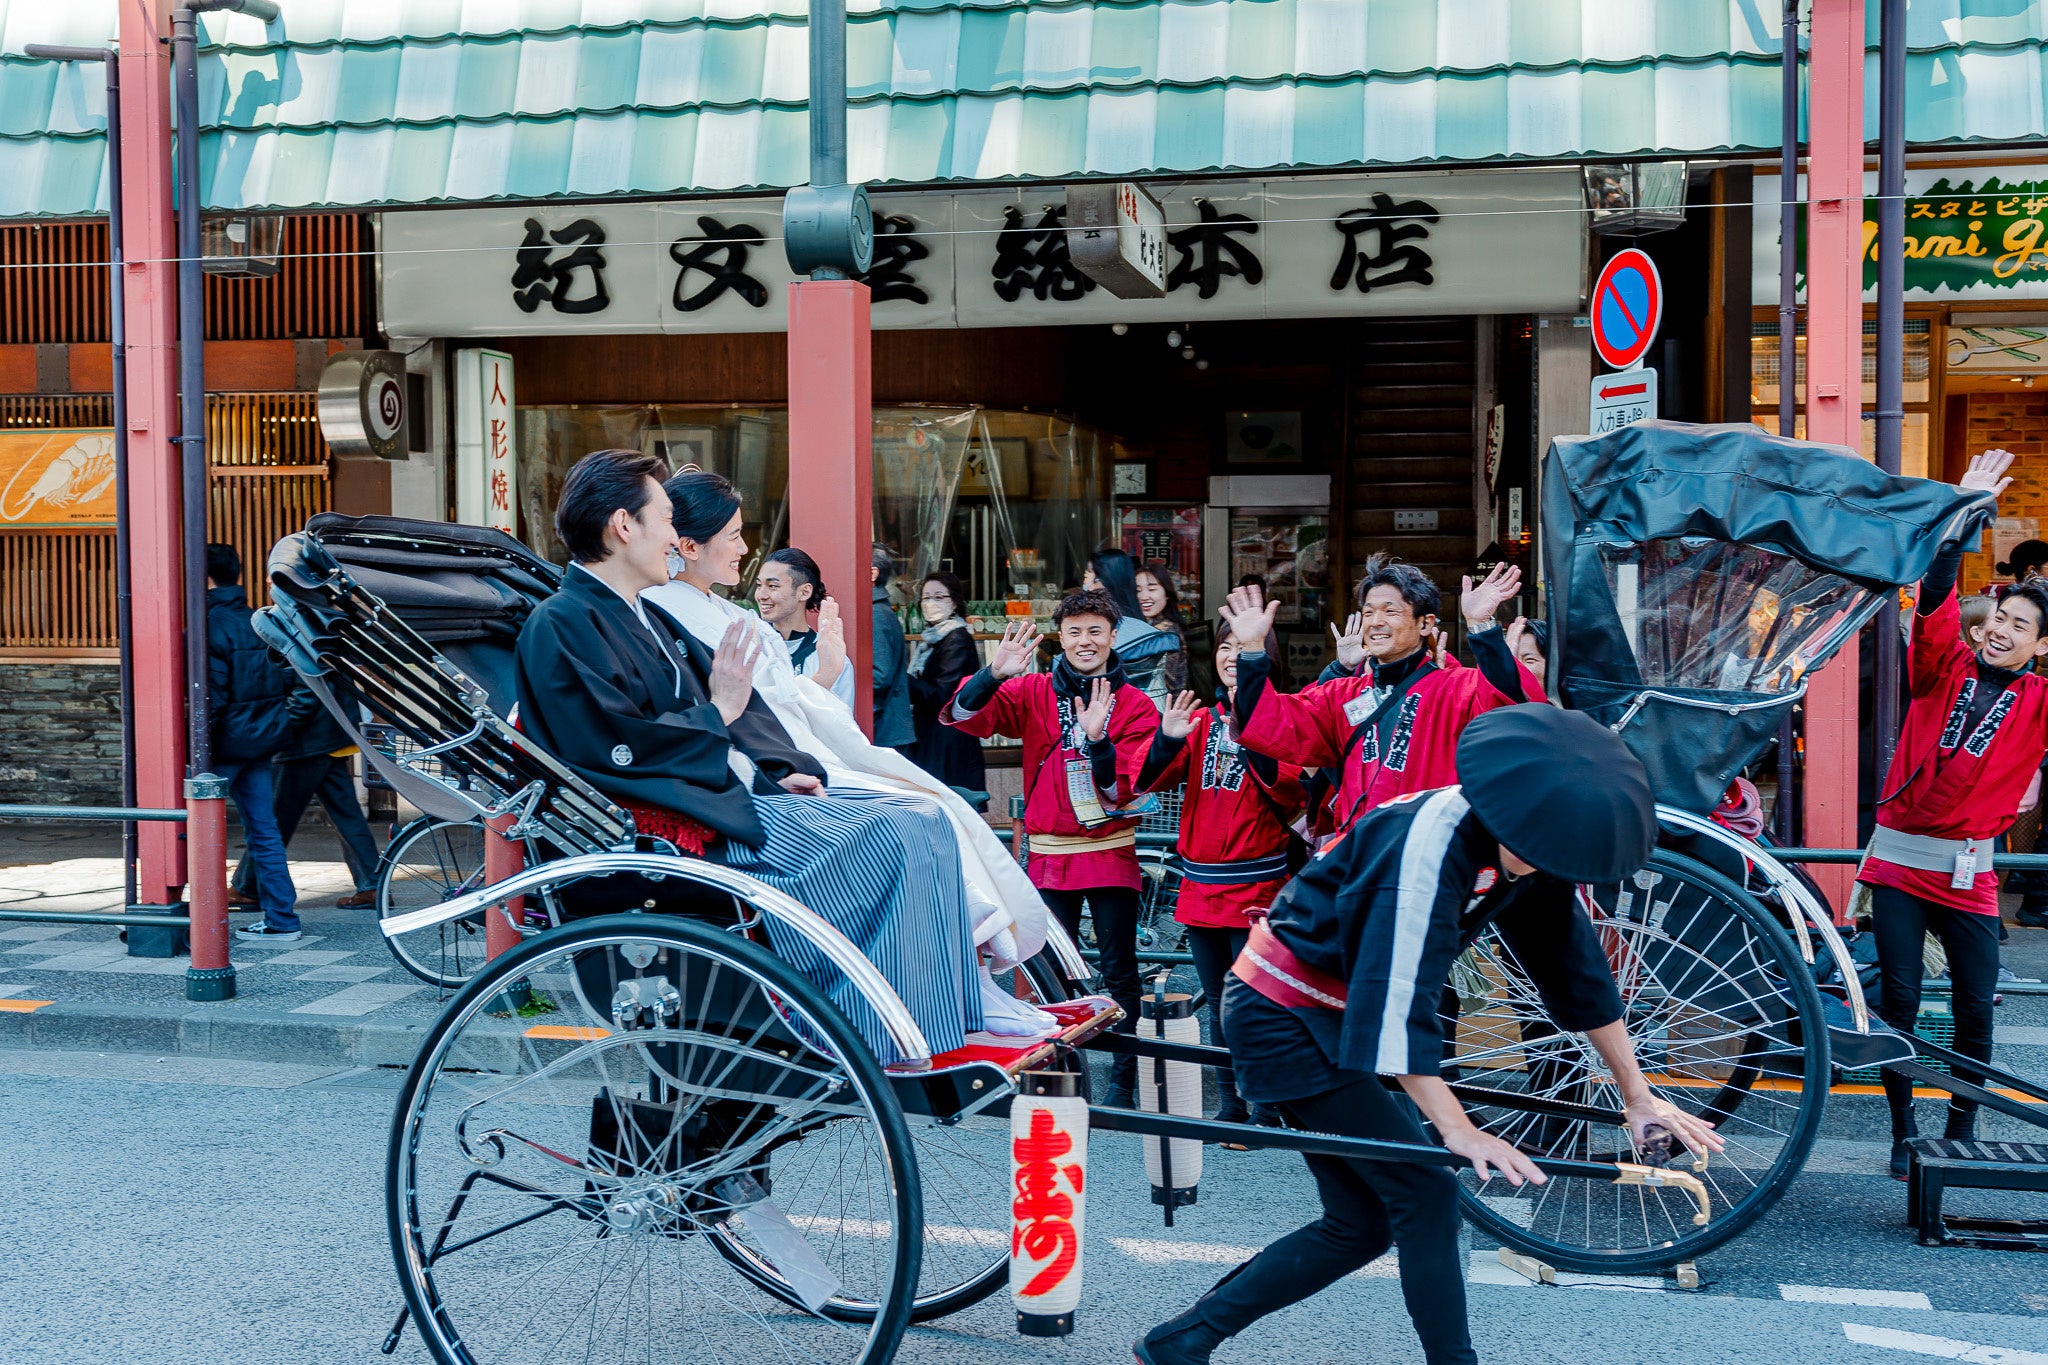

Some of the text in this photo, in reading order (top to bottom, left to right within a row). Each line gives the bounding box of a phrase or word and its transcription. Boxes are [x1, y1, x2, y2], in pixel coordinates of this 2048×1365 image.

[1904, 196, 2048, 219] スタとピザ
[1201, 721, 1220, 790] 東京力車
[1384, 693, 1422, 772] 東京力車
[1963, 690, 2018, 758] 東京力車
